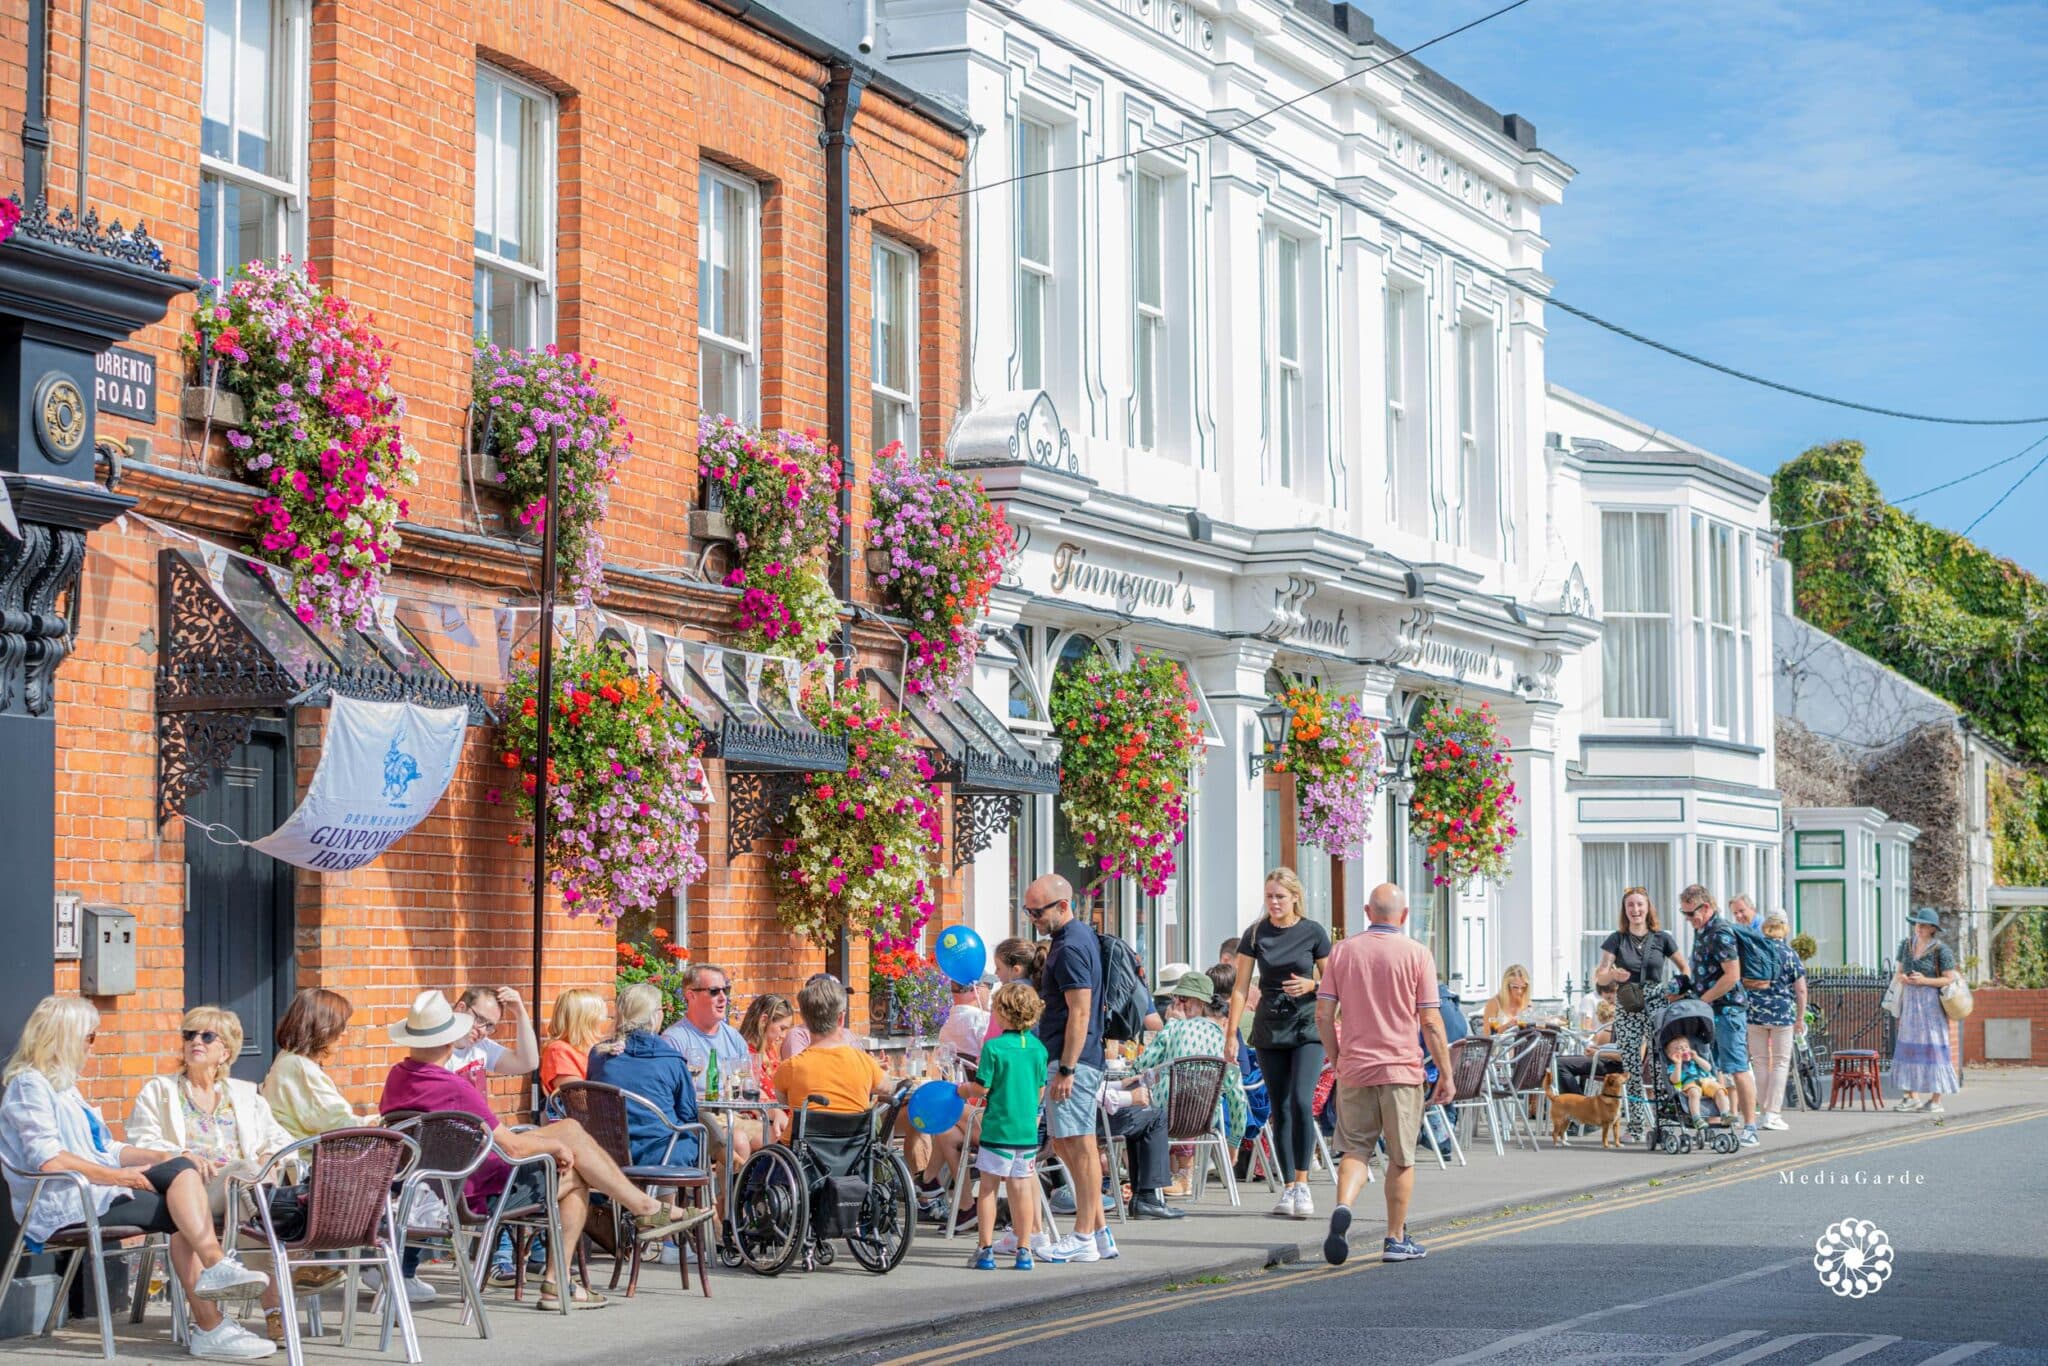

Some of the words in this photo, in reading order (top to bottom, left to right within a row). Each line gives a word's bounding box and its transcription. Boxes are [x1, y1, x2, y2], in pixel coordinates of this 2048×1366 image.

[95, 351, 152, 386] ORRENTO
[95, 377, 147, 410] ROAD
[1050, 541, 1196, 615] Finnegan's
[307, 850, 369, 871] IRISH
